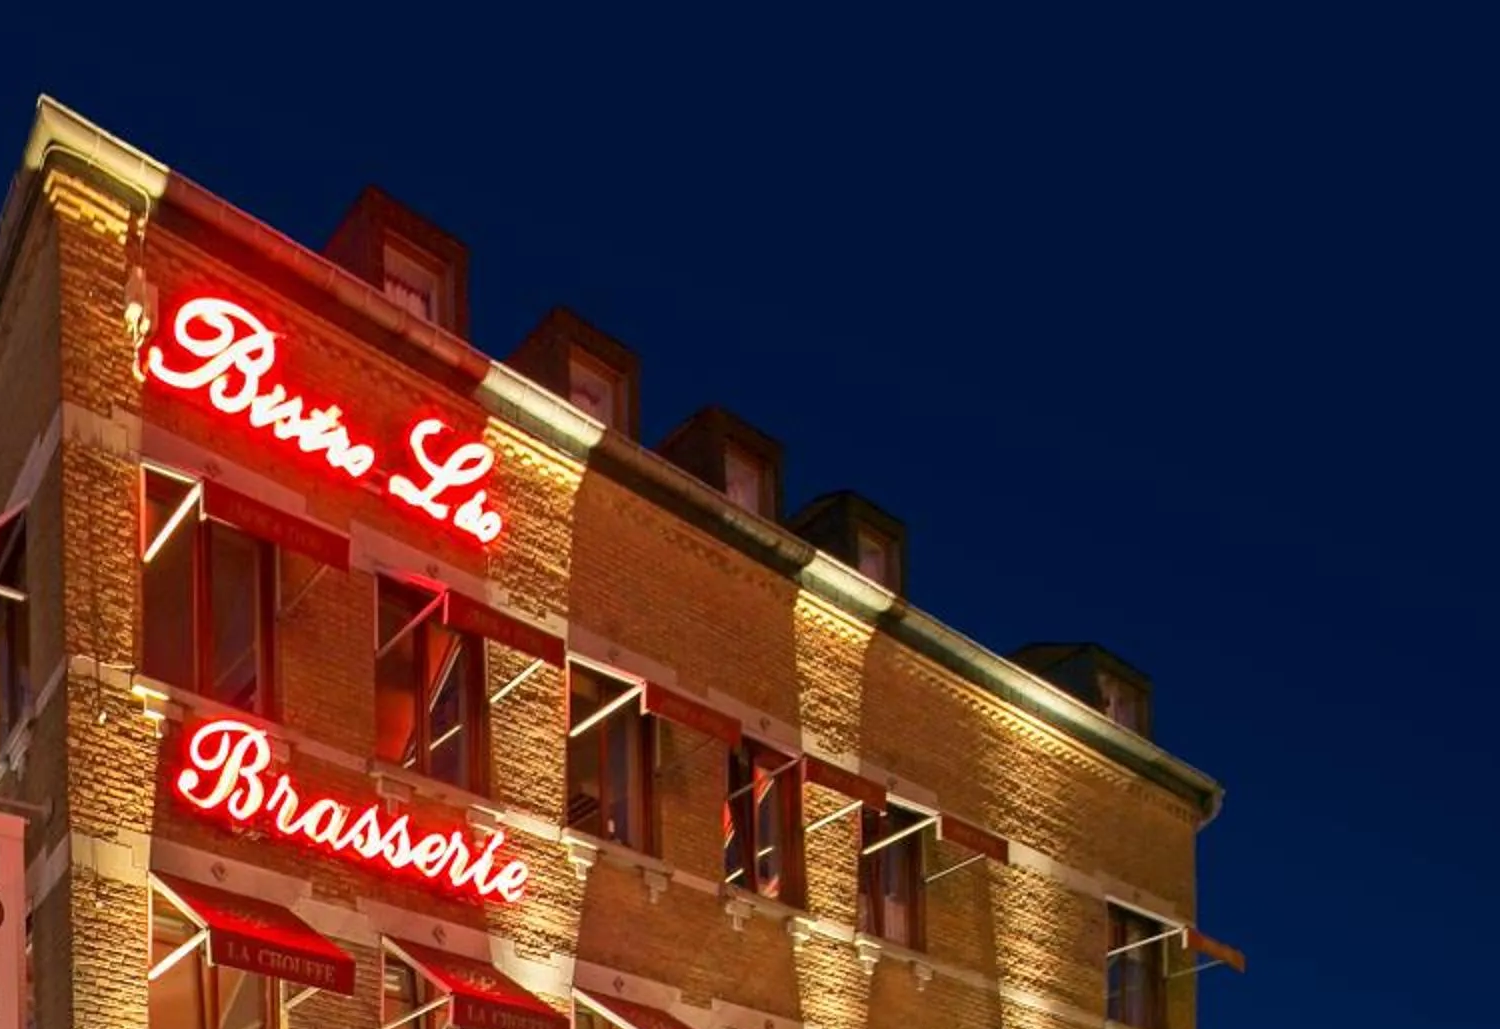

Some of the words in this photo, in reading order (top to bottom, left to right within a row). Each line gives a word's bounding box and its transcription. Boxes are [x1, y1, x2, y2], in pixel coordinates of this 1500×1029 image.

[147, 297, 376, 478] Bistro
[176, 718, 531, 904] Brasserie
[226, 940, 251, 962] LA
